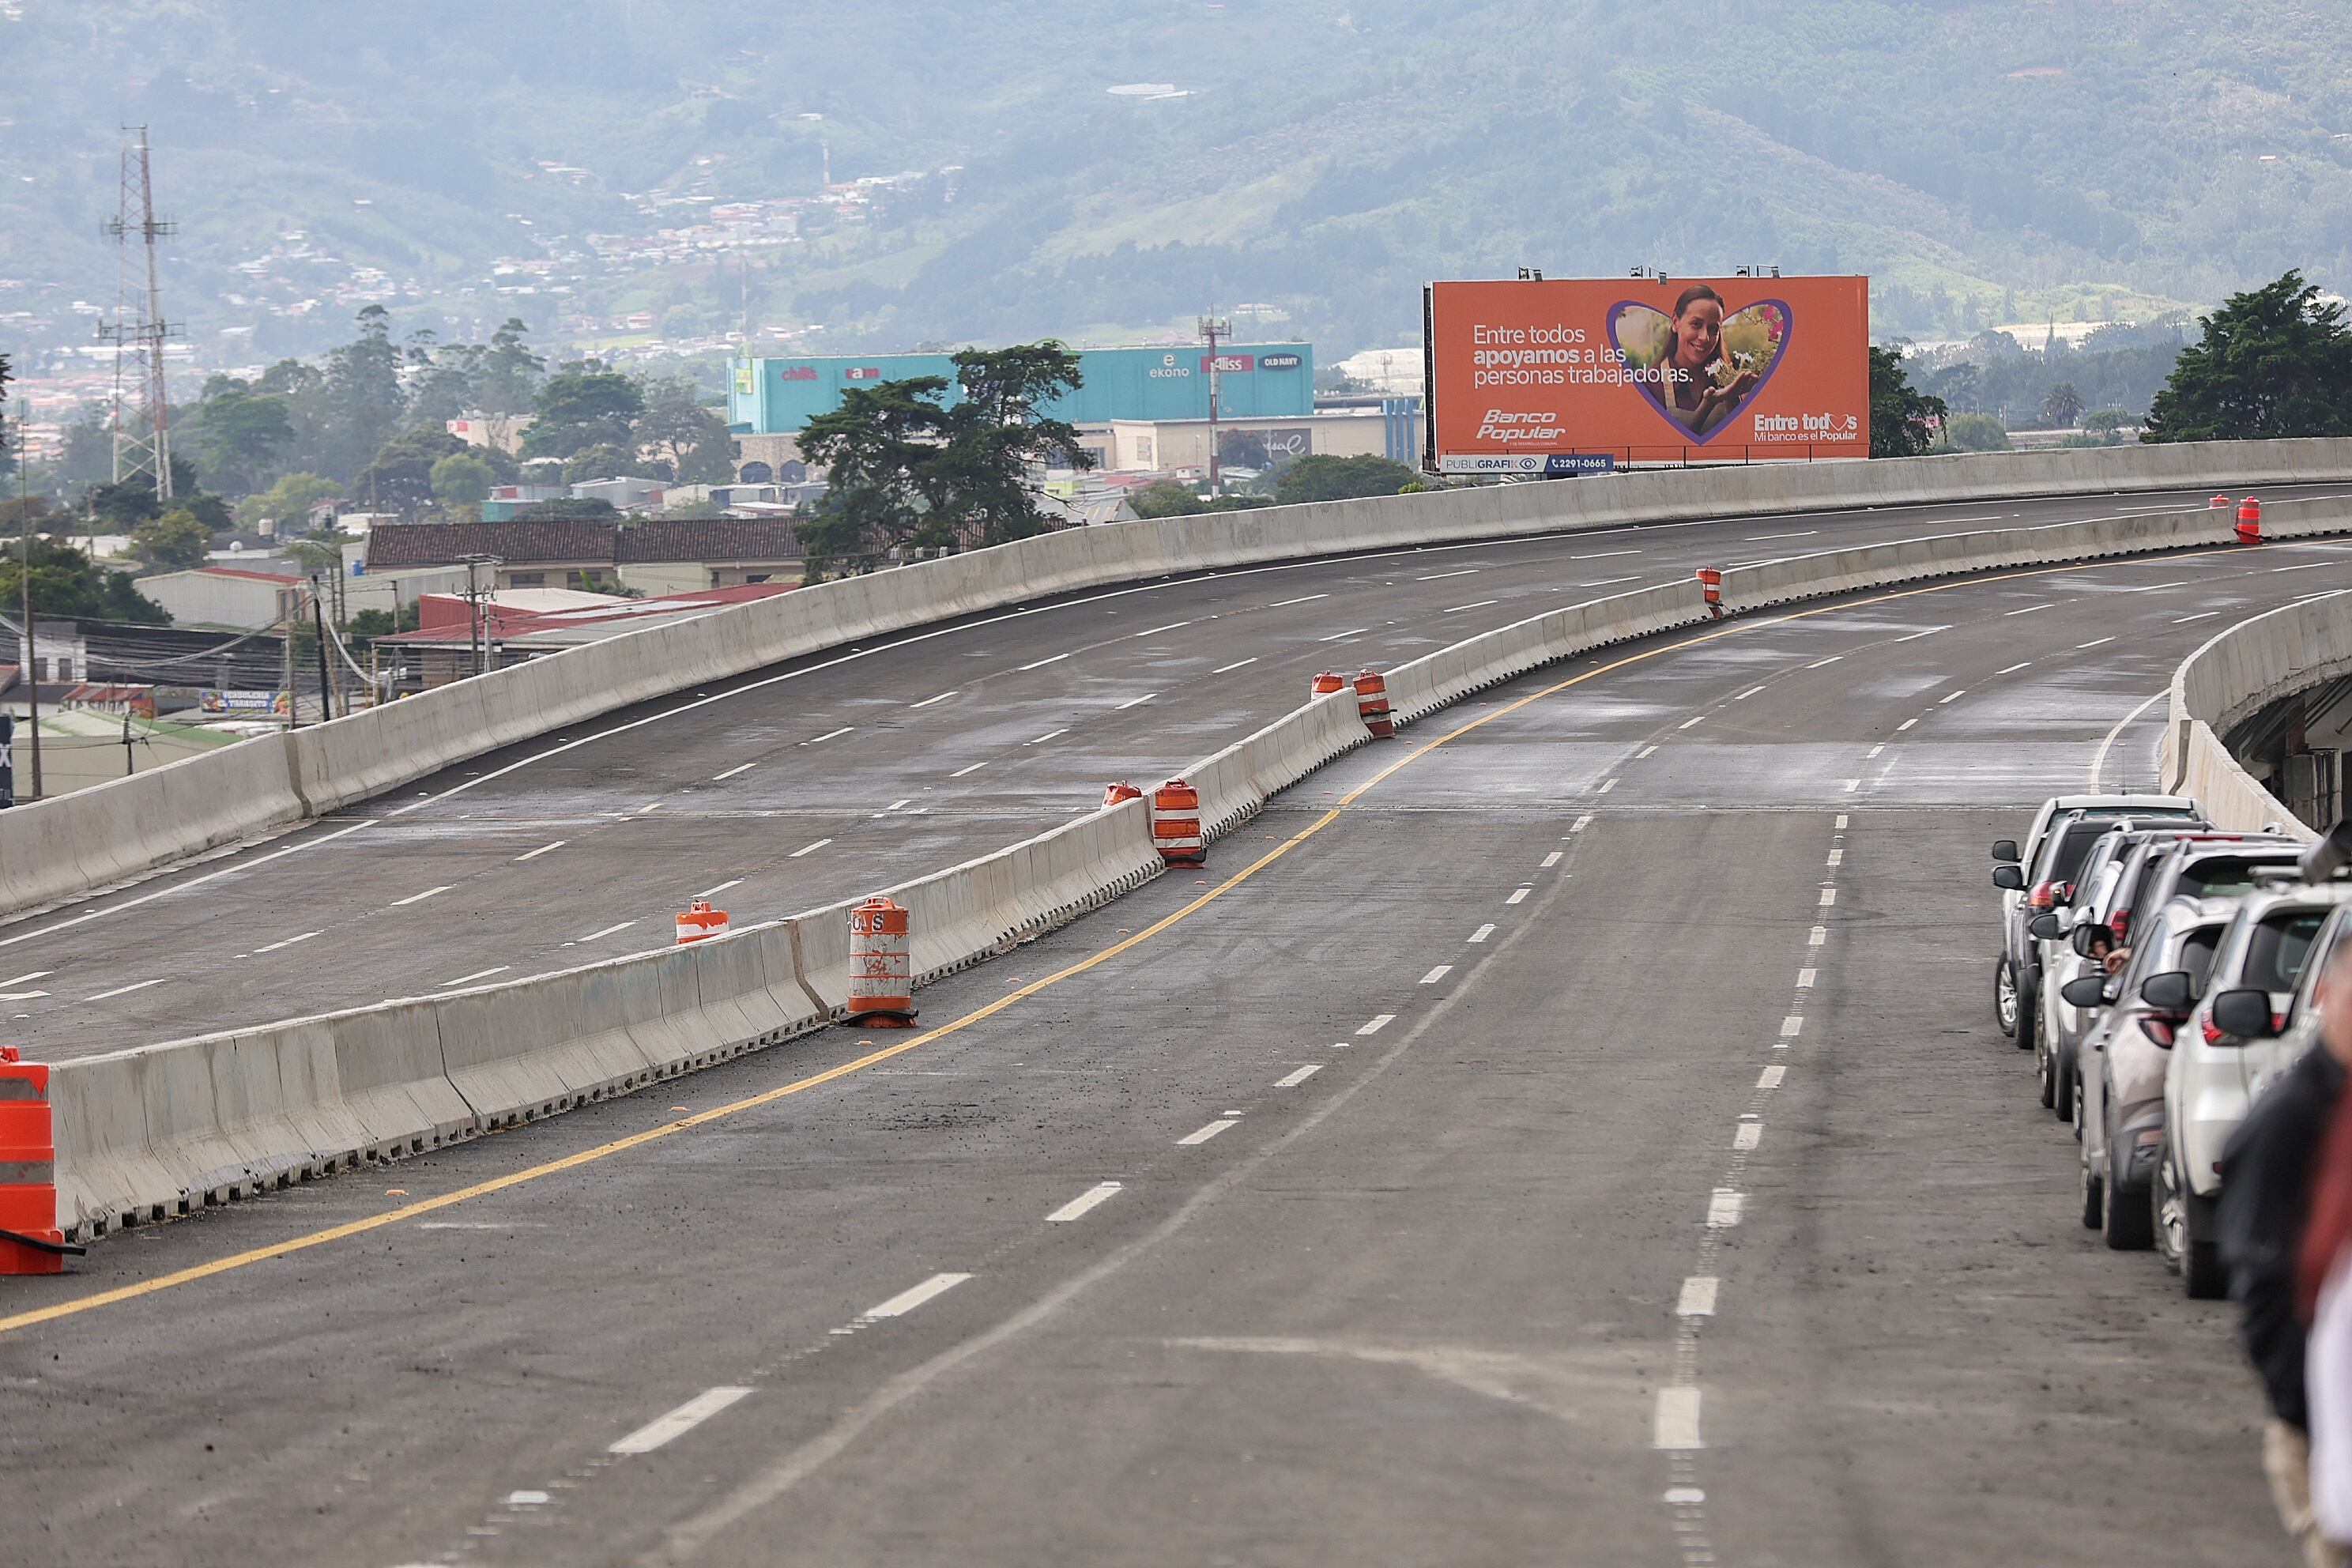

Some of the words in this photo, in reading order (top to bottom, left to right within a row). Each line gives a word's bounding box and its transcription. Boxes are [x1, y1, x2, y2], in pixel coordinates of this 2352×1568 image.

[1473, 325, 1525, 345] Entre
[1528, 323, 1585, 344] todos
[1265, 358, 1279, 367] OLD
[1279, 356, 1298, 366] NAVY
[1473, 348, 1581, 368] apoyamos
[1584, 350, 1595, 364] a
[1600, 344, 1626, 364] las
[1149, 366, 1189, 379] ekono
[1474, 368, 1564, 389] personas
[1567, 363, 1694, 387] trabajadoras.
[1482, 409, 1557, 424] Banco
[1754, 413, 1799, 432] Entre
[1476, 424, 1566, 443] Popular
[1754, 432, 1766, 442] Mi
[1767, 431, 1796, 442] banco
[1797, 433, 1809, 442] es
[1810, 431, 1819, 441] el
[1819, 430, 1857, 443] Popular
[1446, 458, 1518, 469] PUBLIGRAFIK
[1559, 458, 1607, 469] 2291-0665
